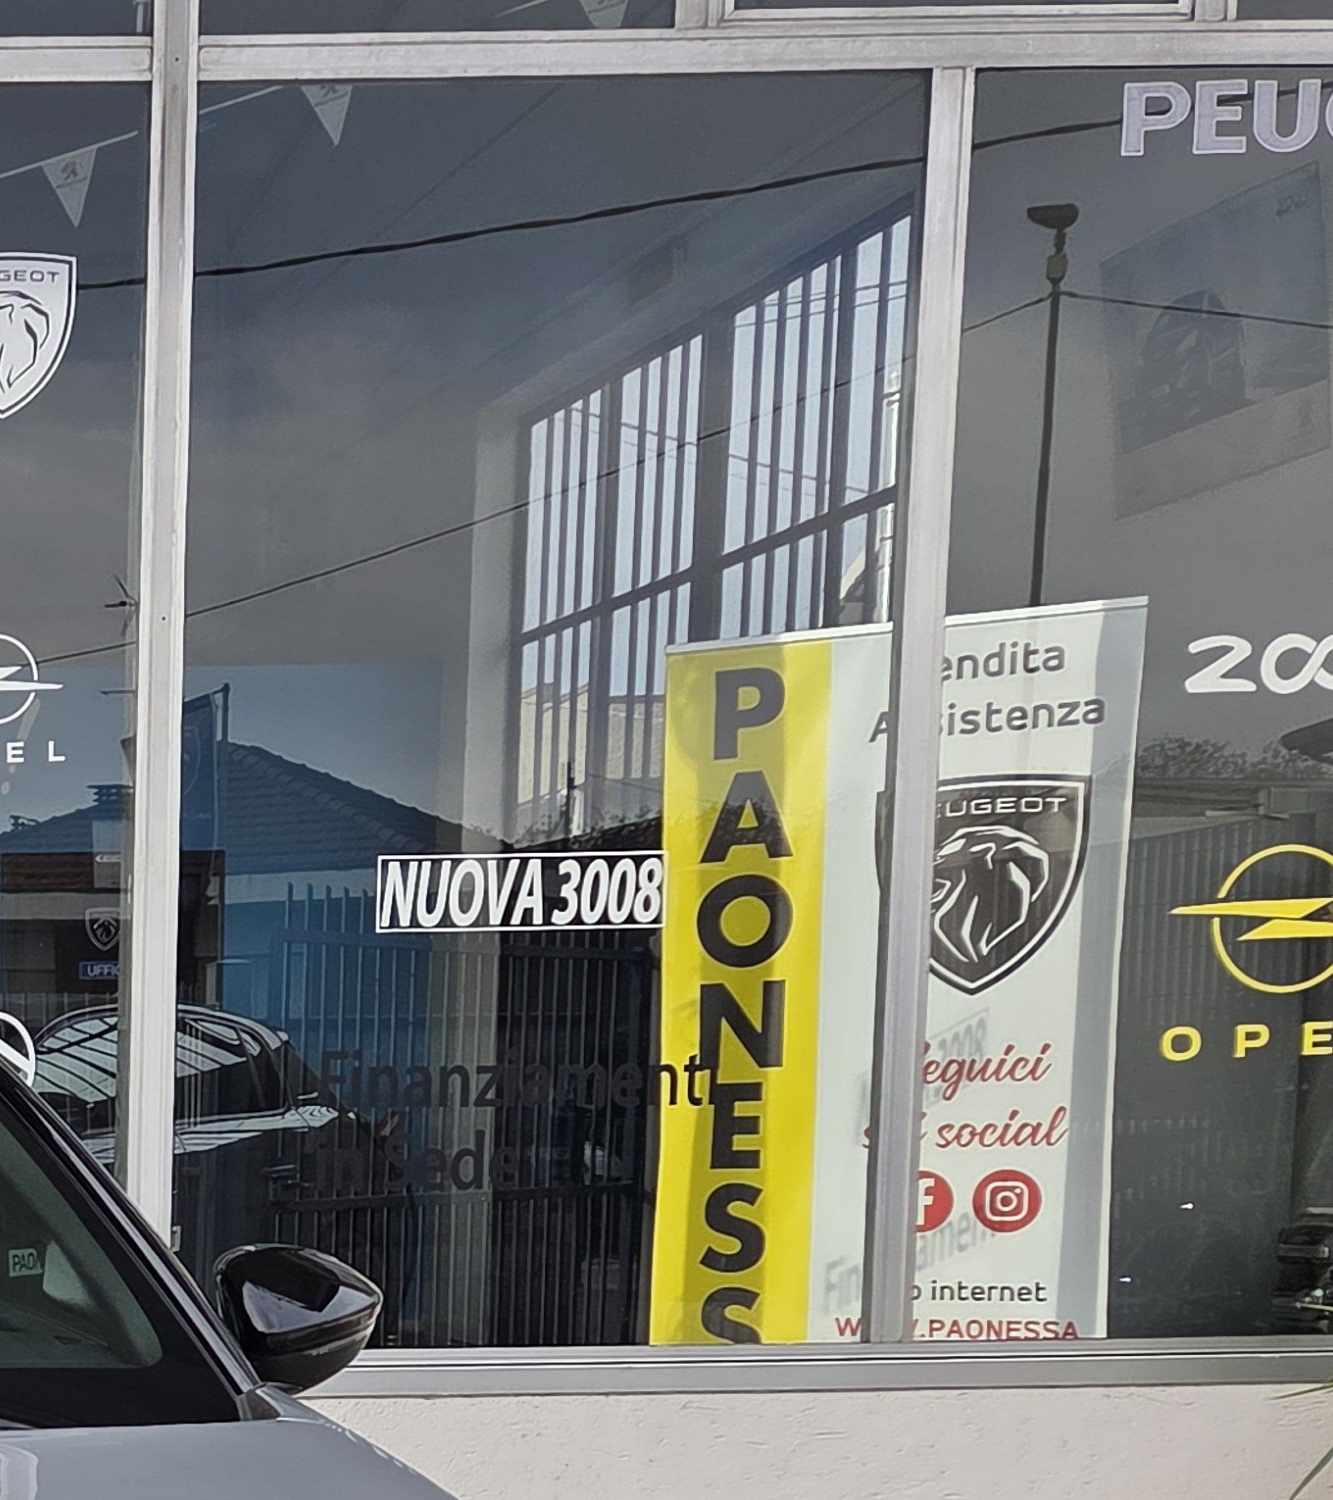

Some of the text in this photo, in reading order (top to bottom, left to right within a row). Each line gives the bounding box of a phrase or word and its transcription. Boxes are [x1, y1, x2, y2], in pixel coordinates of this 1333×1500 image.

[1120, 78, 1333, 157] PEU
[939, 640, 1066, 684] endita
[868, 697, 1106, 744] Aistenza
[937, 797, 1067, 818] UGEOT
[380, 857, 665, 928] NUOVA 3008
[1159, 1020, 1333, 1062] OPE
[923, 1041, 1053, 1102] eguici
[935, 1105, 1069, 1149] social
[932, 1279, 1048, 1302] internet
